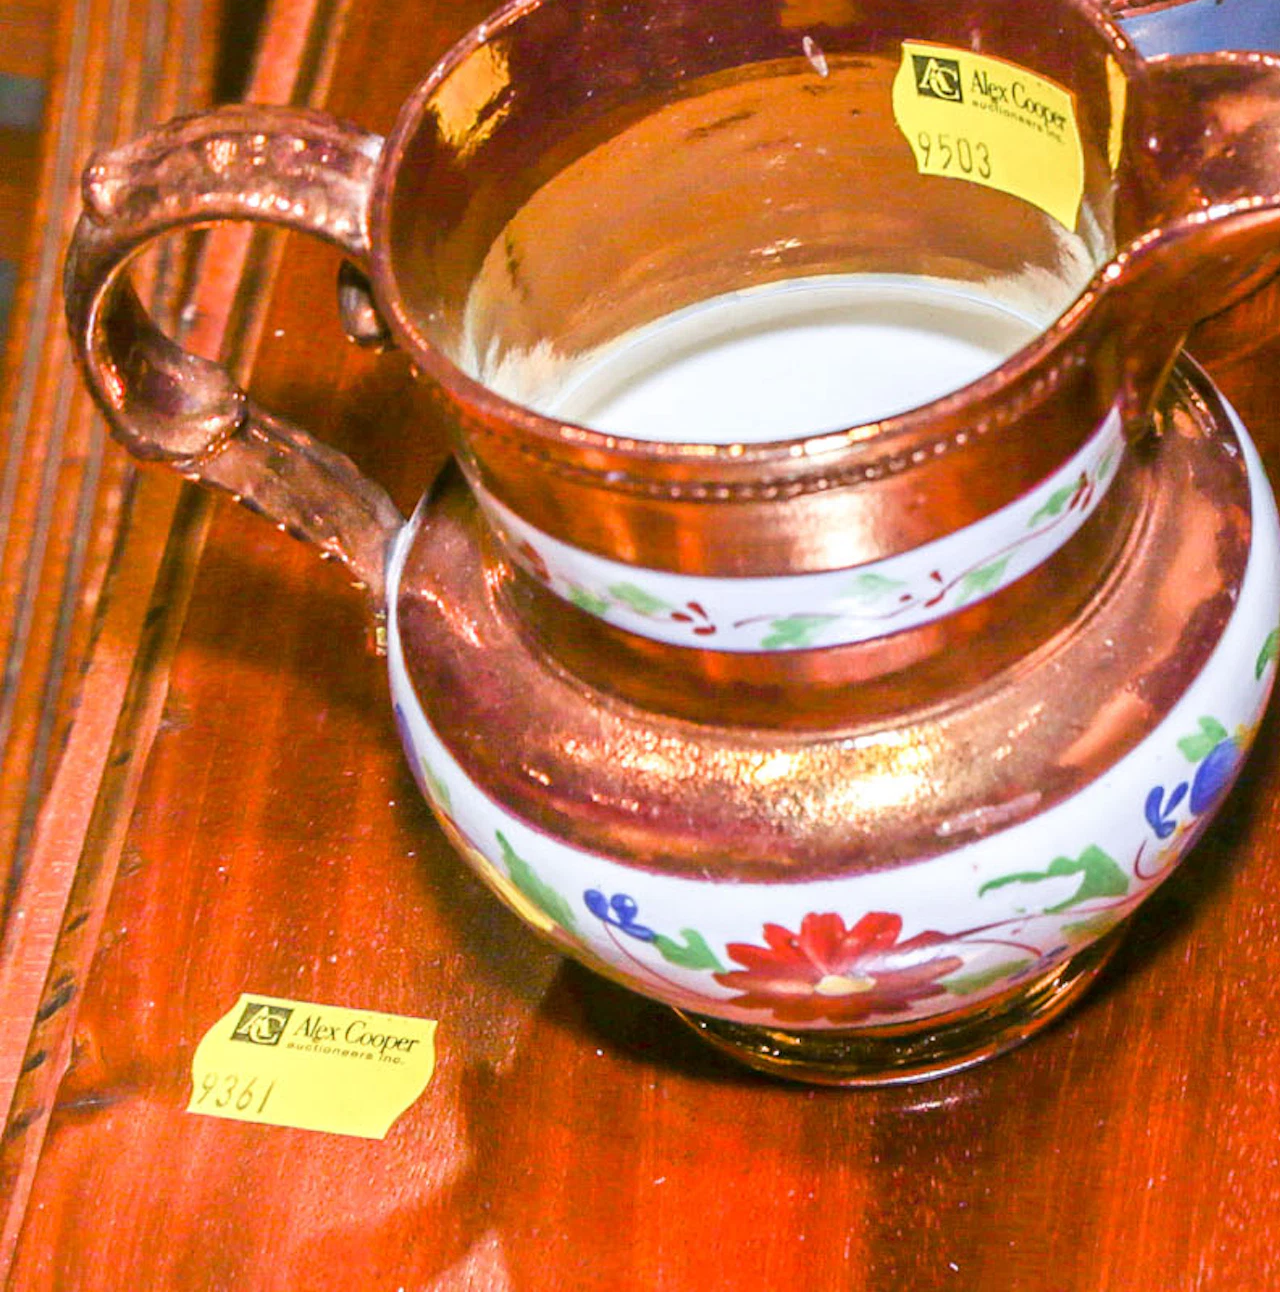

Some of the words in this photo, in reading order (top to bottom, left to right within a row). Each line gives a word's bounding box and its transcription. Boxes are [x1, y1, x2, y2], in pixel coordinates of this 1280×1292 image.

[971, 69, 1008, 102] Alex
[1012, 81, 1067, 131] Cooper
[917, 130, 991, 180] 9503
[286, 1042, 373, 1061] auctioneers
[379, 1052, 406, 1065] inc.
[293, 1015, 341, 1044] Alex
[345, 1020, 420, 1055] Cooper
[197, 1072, 275, 1114] 9361
